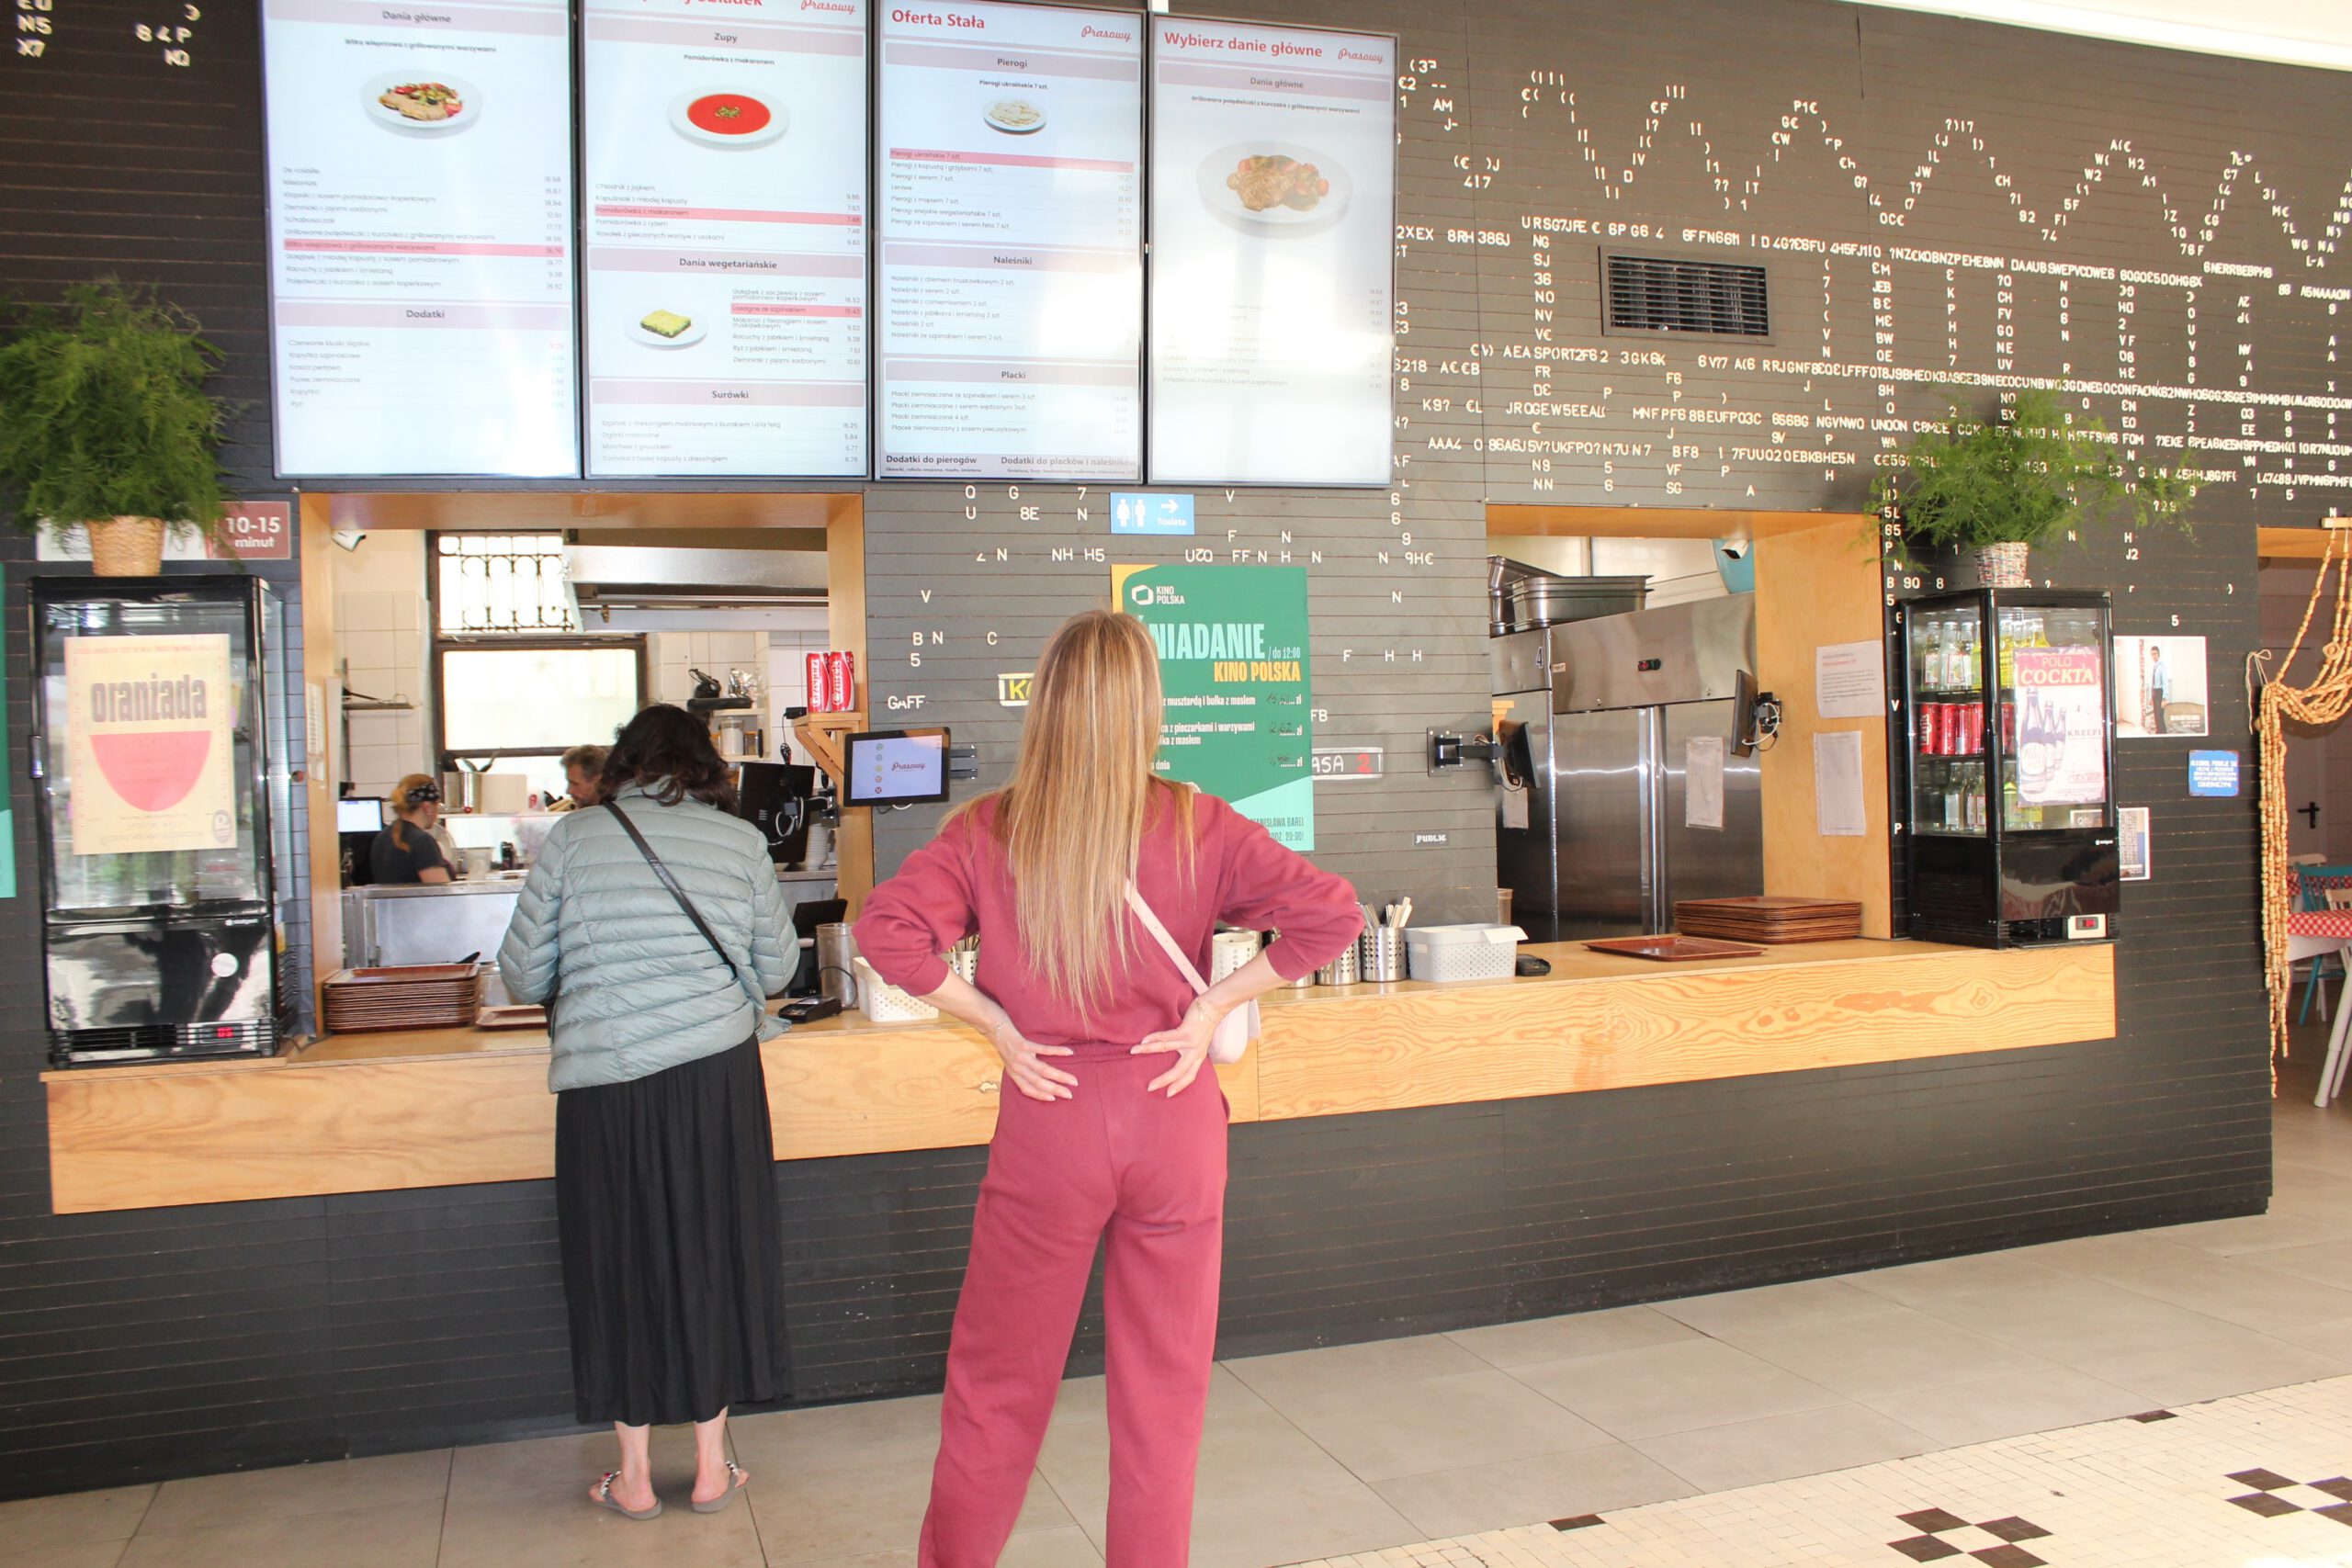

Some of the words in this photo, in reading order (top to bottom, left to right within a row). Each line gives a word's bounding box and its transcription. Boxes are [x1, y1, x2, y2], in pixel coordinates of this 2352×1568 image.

[382, 11, 411, 21] Dania
[413, 12, 451, 23] główne
[892, 9, 942, 26] Oferta
[947, 14, 985, 28] Stała
[715, 33, 738, 43] Zupy
[1081, 26, 1131, 42] Prasowy
[1165, 32, 1224, 48] Wybierz
[1228, 38, 1266, 52] danie
[1272, 41, 1322, 57] główne
[684, 54, 729, 62] Pomidorówka
[1338, 49, 1384, 63] Prasowy
[998, 58, 1027, 69] Pierogi
[979, 79, 1001, 87] Pierogi
[1001, 81, 1034, 89] ukraińskie
[1250, 77, 1272, 87] Dania
[1274, 79, 1304, 89] główne
[1433, 99, 1453, 112] AM
[1916, 166, 1931, 177] JW
[2085, 169, 2101, 181] W2
[1533, 234, 1549, 248] NG
[680, 258, 706, 266] Dania
[708, 260, 777, 269] wegetariańskie
[994, 255, 1032, 265] Naleśniki
[1533, 254, 1549, 267] SJ
[1534, 273, 1551, 286] 36
[406, 310, 445, 318] Dodatki
[1535, 309, 1552, 321] NV
[1998, 308, 2011, 320] FV
[1876, 333, 1894, 344] BW
[1996, 342, 2013, 354] NE
[1998, 358, 2012, 370] UV
[1001, 371, 1025, 379] Placki
[1535, 366, 1550, 378] FR
[712, 390, 749, 399] Surówki
[936, 457, 978, 466] pierogów
[1001, 457, 1035, 465] Dodatki
[1050, 457, 1083, 466] placków
[1532, 459, 1550, 472] N9
[1667, 464, 1681, 476] VF
[1009, 486, 1019, 500] G
[1078, 487, 1086, 500] 7
[1667, 482, 1681, 494] SG
[967, 506, 976, 519] U
[1021, 507, 1039, 520] 8E
[226, 516, 281, 534] 10-15
[234, 536, 275, 548] minut
[1228, 530, 1237, 542] F
[1052, 548, 1072, 561] NH
[1084, 548, 1104, 561] H5
[1233, 550, 1250, 562] FF
[2126, 548, 2138, 559] J2
[1157, 586, 1174, 594] KINO
[1157, 595, 1185, 604] POLSKA
[1140, 615, 1265, 660] NIADANIE
[1283, 647, 1300, 659] 12:00
[1536, 647, 1544, 669] 4
[2042, 656, 2072, 667] POLO
[1214, 661, 1247, 682] KINO
[1250, 660, 1301, 682] POLSKA
[2021, 668, 2095, 684] COCKTA
[92, 674, 207, 723] oranżada
[1168, 696, 1202, 708] musztardą
[1206, 695, 1224, 705] bułka
[1231, 694, 1255, 705] masłem
[1296, 694, 1301, 705] zł
[1174, 722, 1213, 735] pieczarkami
[1218, 721, 1254, 734] warzywami
[1296, 726, 1302, 736] zł
[1176, 735, 1201, 745] masłem
[891, 761, 926, 772] Prasowy
[1156, 760, 1170, 770] dnia
[1296, 757, 1302, 767] zł
[1311, 755, 1344, 773] ASA
[1356, 753, 1373, 773] 2
